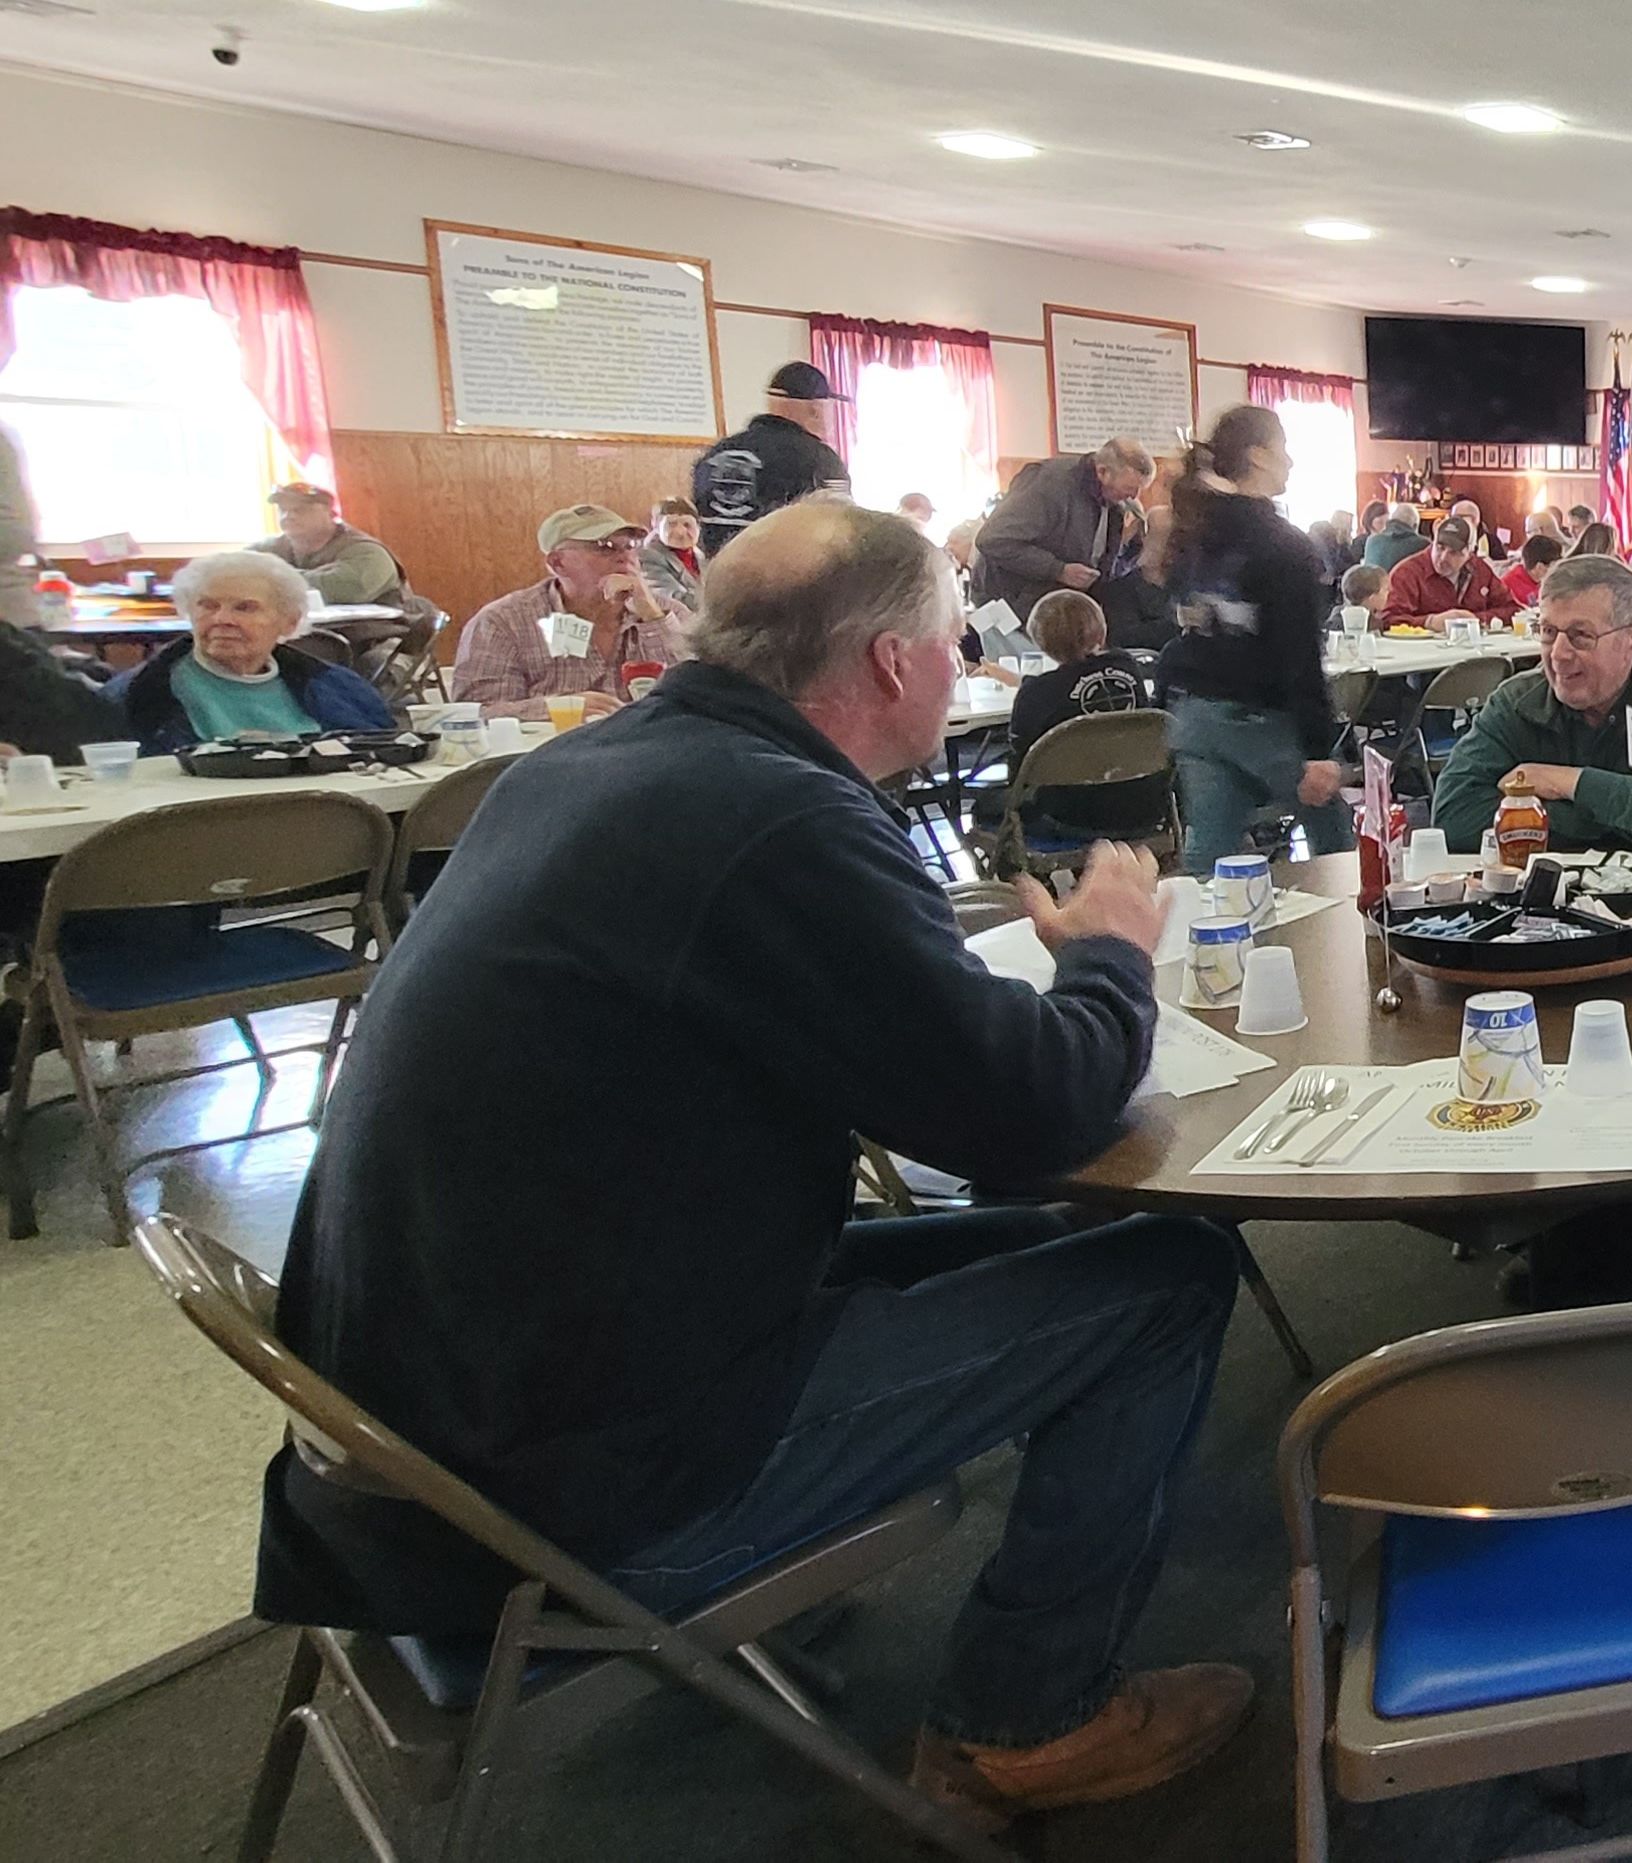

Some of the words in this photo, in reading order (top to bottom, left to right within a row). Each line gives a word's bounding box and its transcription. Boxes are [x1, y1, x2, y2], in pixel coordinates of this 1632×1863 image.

[533, 256, 544, 267] of
[547, 259, 565, 270] The
[568, 262, 615, 277] American
[617, 268, 650, 282] Legion
[463, 264, 518, 279] PREAMBLE
[522, 270, 537, 281] TO
[540, 273, 559, 284] THE
[561, 275, 614, 292] NATIONAL
[617, 281, 687, 299] CONSTITUTION
[573, 623, 589, 638] 18
[1105, 667, 1137, 686] County
